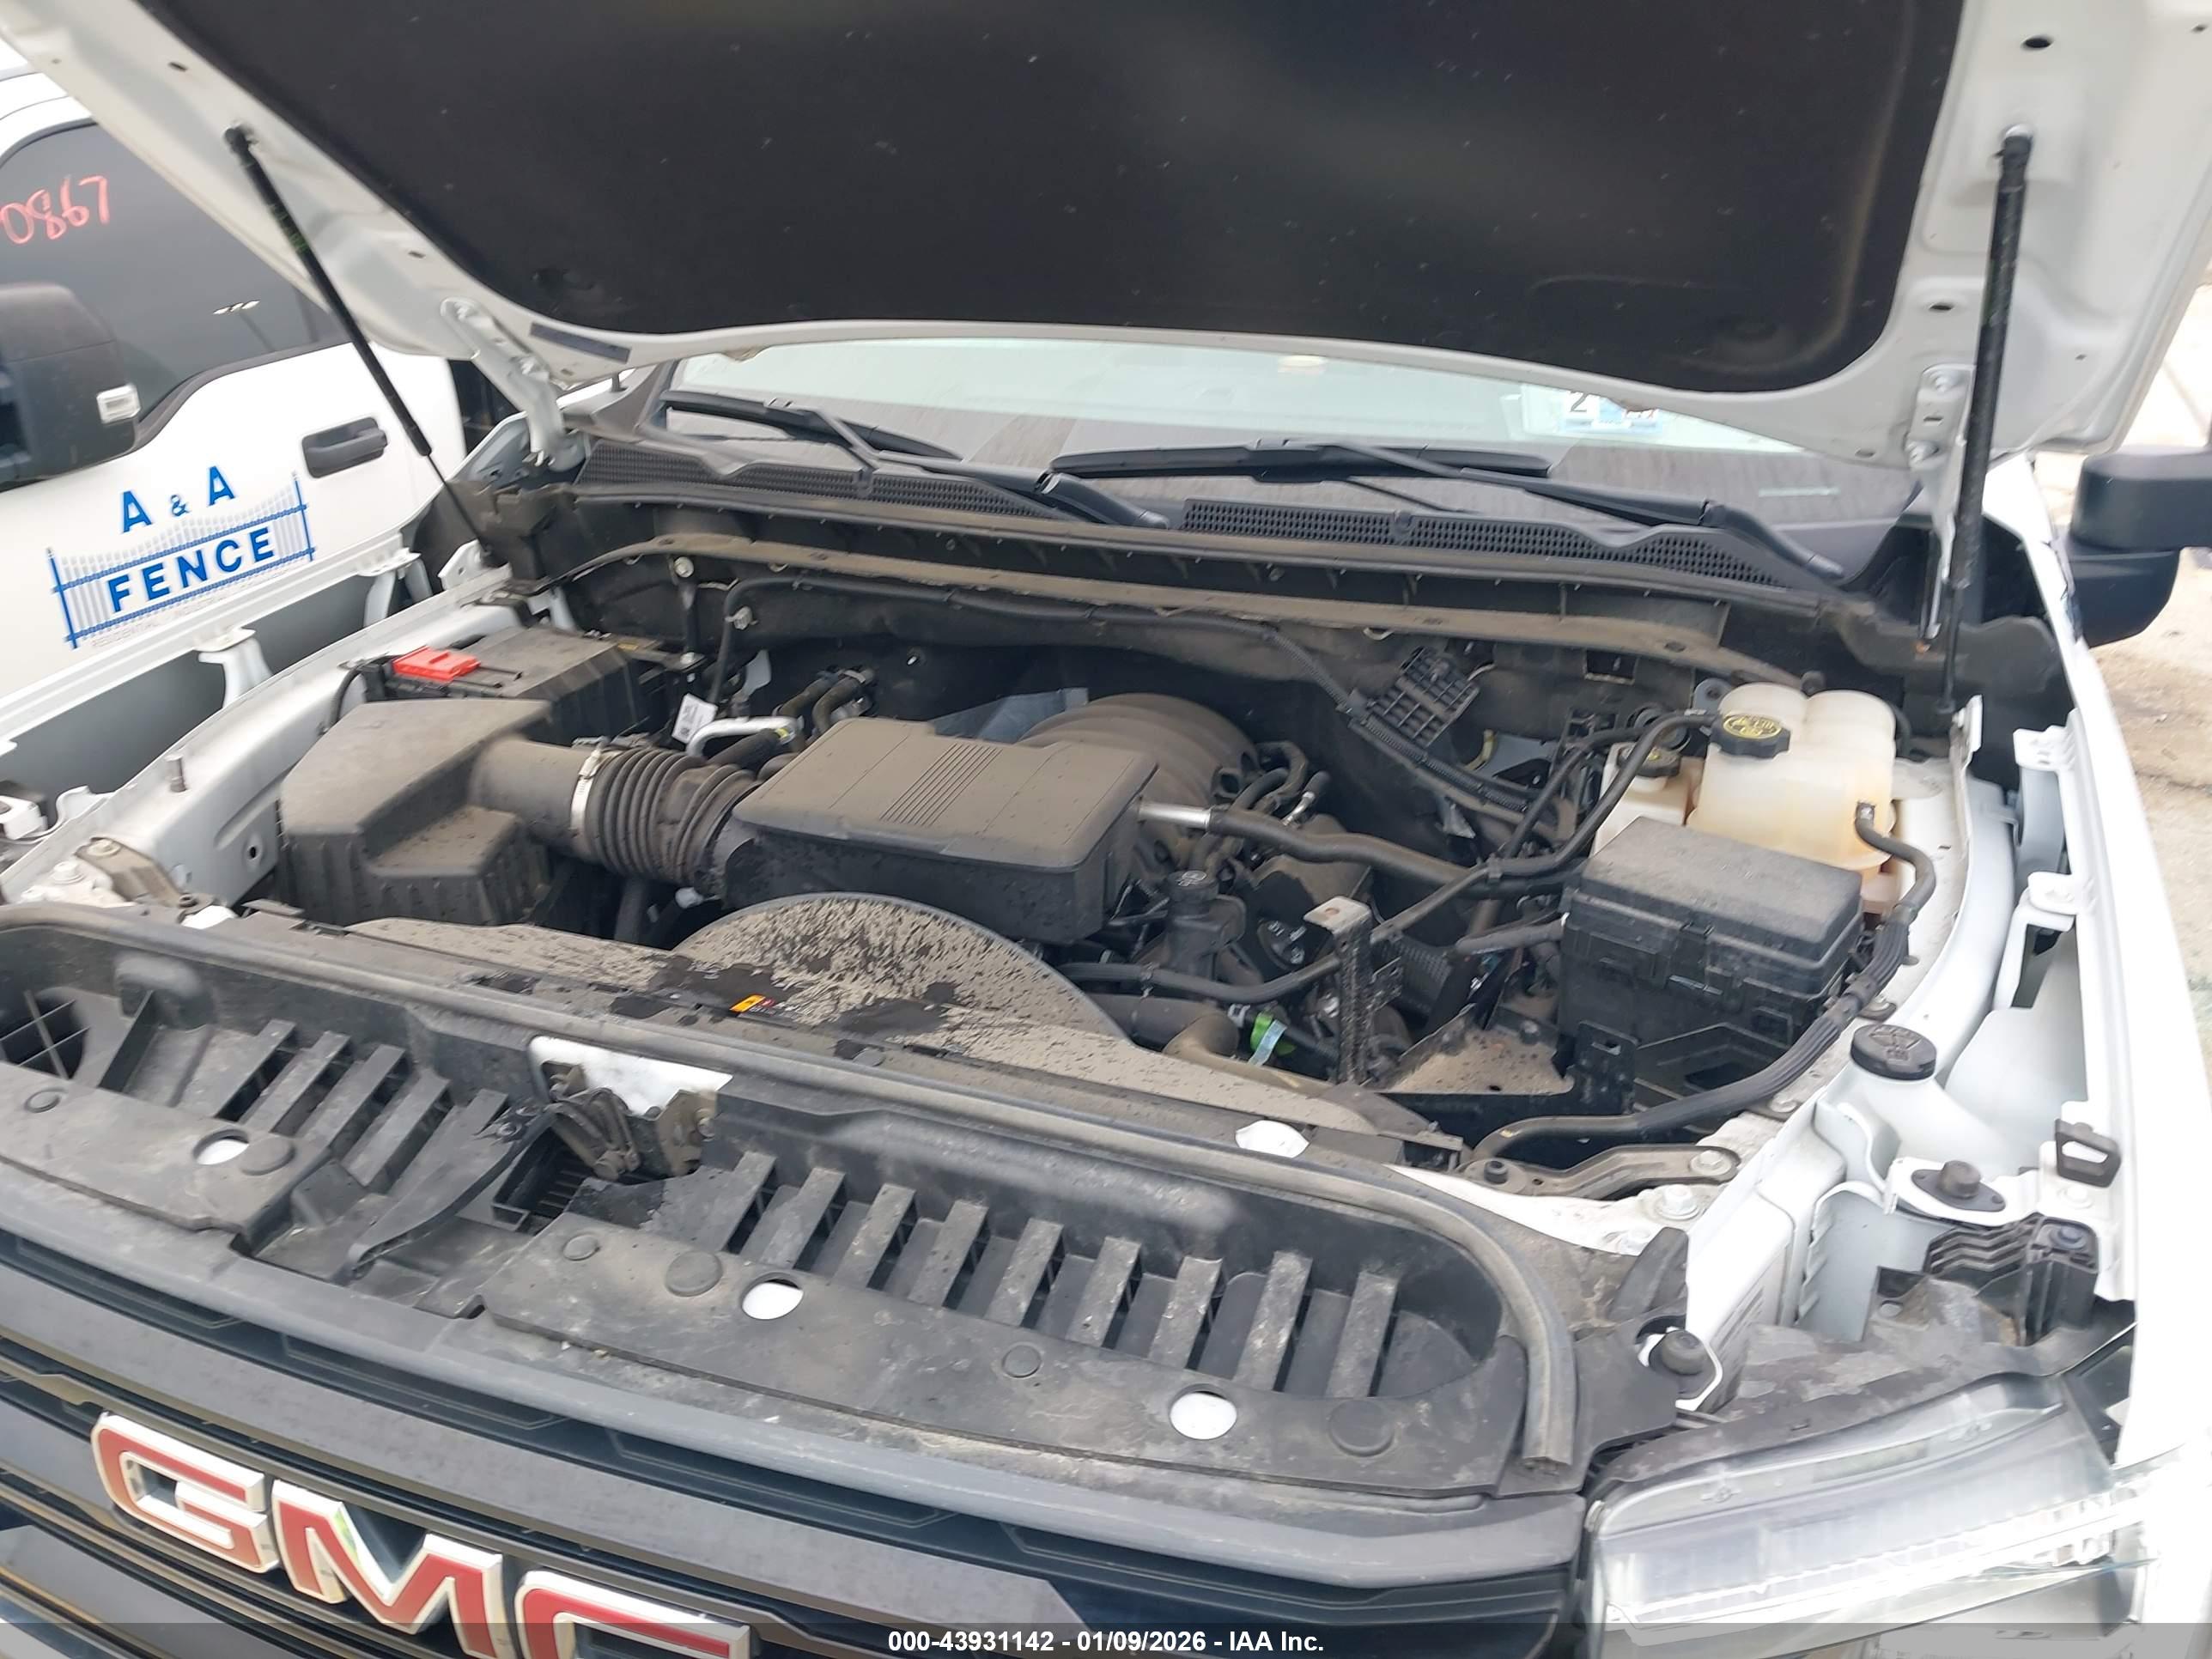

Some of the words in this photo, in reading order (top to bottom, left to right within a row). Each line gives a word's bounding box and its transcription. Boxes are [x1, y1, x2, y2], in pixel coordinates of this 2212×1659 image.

[0, 174, 111, 245] 0867
[121, 489, 152, 533] A
[170, 494, 191, 517] &
[207, 465, 235, 507] A
[106, 526, 275, 613] FENCE
